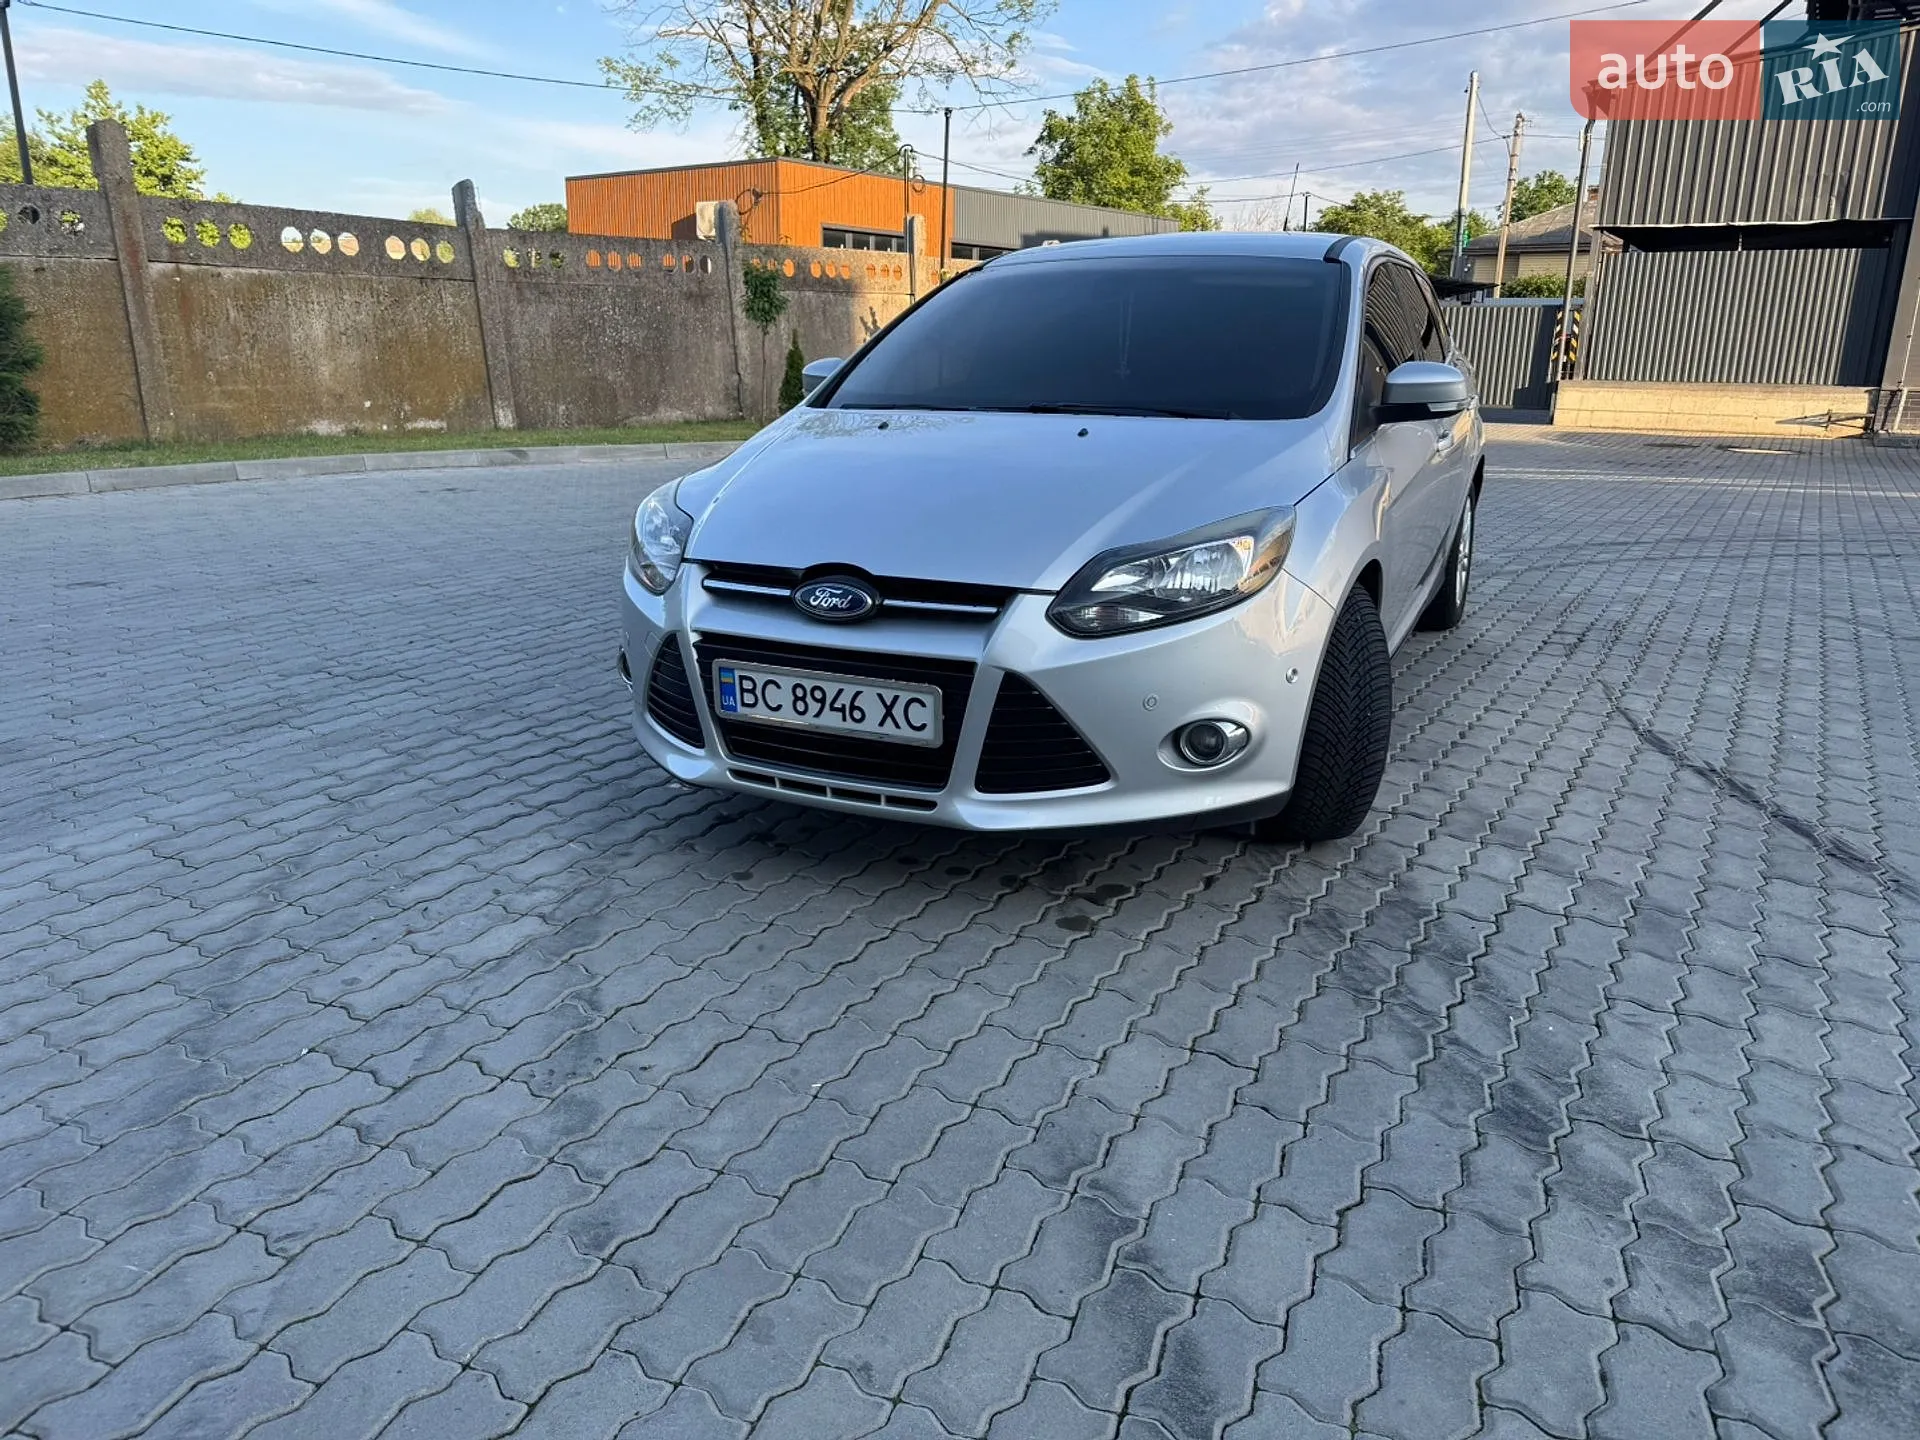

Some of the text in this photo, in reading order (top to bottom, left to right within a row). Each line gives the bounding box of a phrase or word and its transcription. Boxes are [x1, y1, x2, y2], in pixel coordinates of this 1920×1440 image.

[810, 587, 852, 609] Ford
[722, 695, 736, 707] UA
[739, 674, 928, 732] BC 8946 XC
